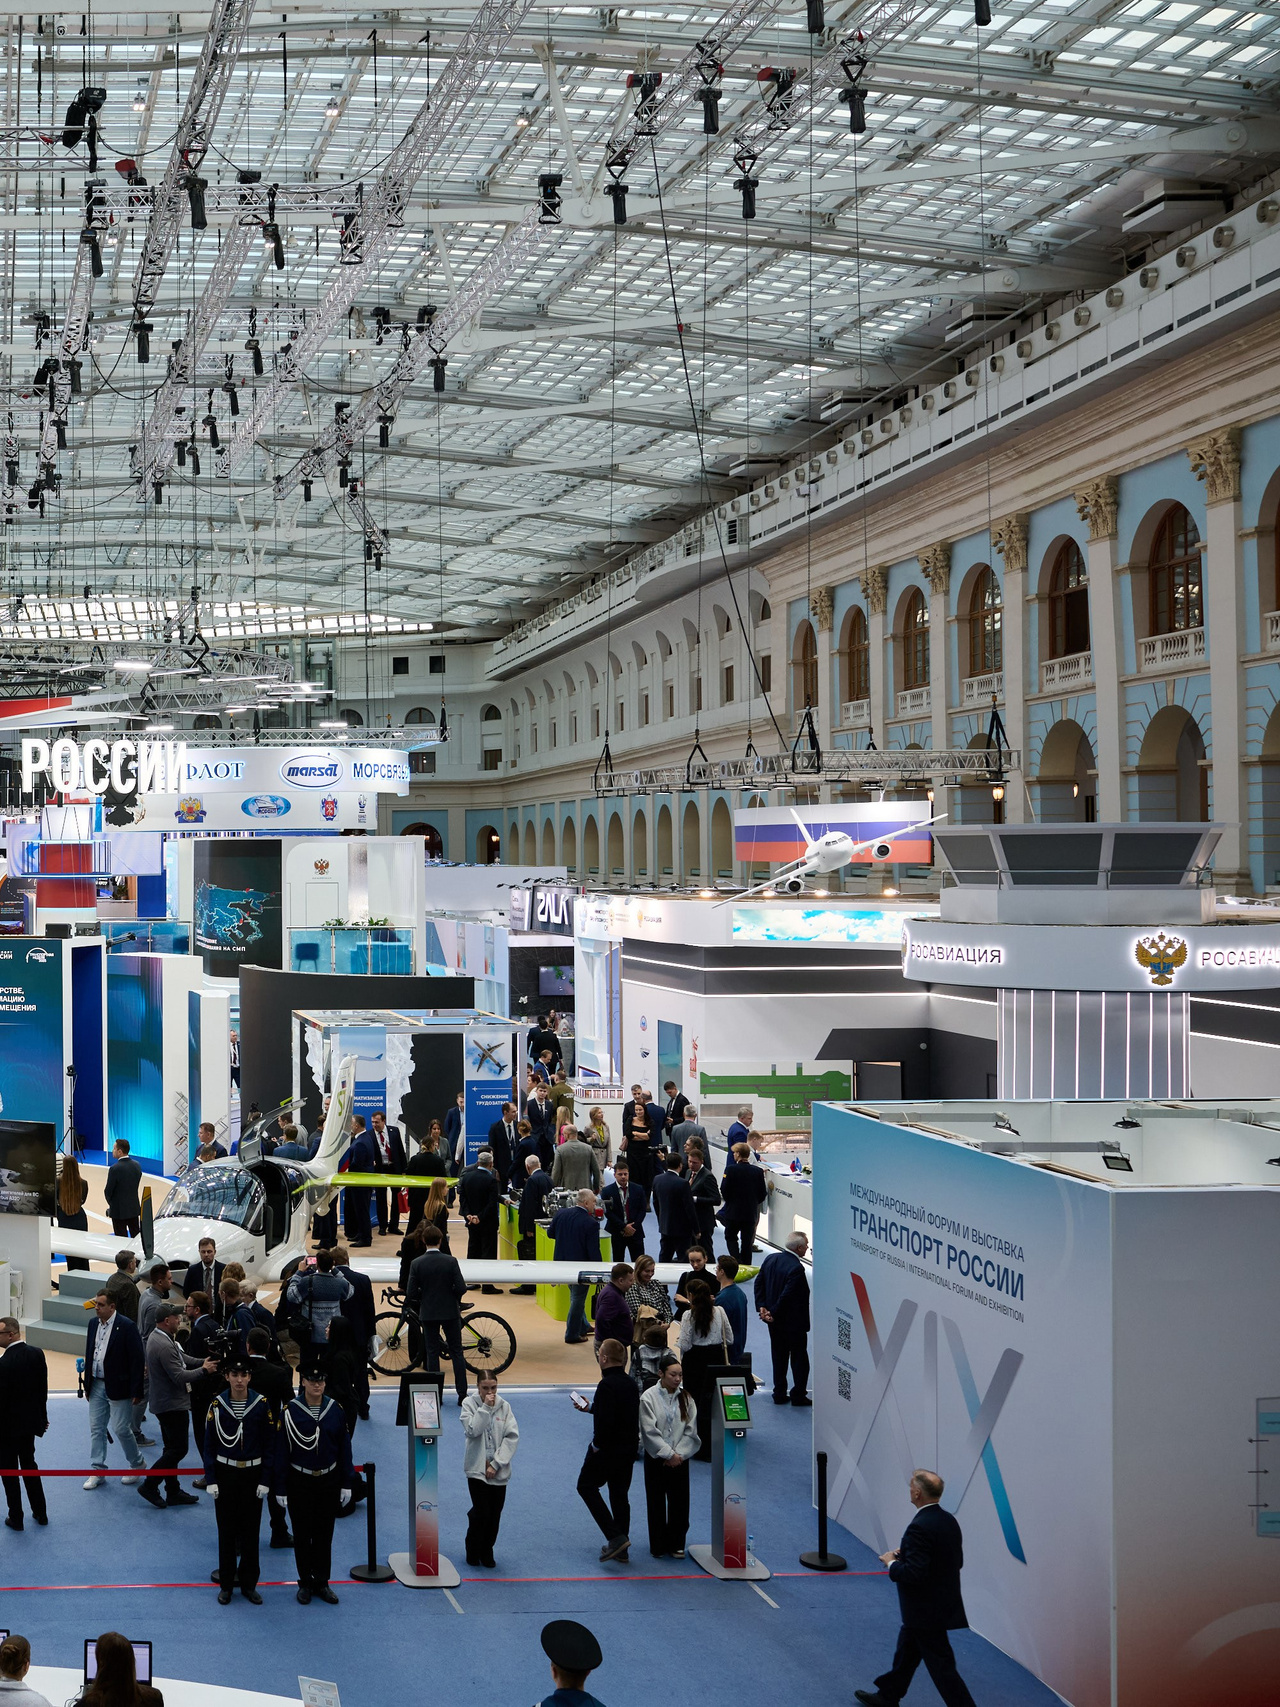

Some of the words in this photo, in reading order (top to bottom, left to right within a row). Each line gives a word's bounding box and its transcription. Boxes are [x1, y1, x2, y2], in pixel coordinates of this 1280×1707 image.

[21, 738, 187, 794] РОССИИ
[911, 944, 1001, 965] РОСАВИАЦИЯ
[850, 1182, 926, 1222] МЕЖДУНАРОДНЫЙ
[927, 1212, 960, 1237] ФОРУМ
[962, 1226, 970, 1240] И
[971, 1228, 1025, 1262] ВЫСТАВКА
[850, 1205, 943, 1265] ТРАНСПОРТ
[947, 1244, 1024, 1301] РОССИИ
[850, 1237, 879, 1258] TRANSPORT
[879, 1251, 887, 1261] OF
[887, 1255, 906, 1270] RUSSIA
[909, 1265, 951, 1290] INTERNATIONAL
[952, 1283, 973, 1300] FORUM
[974, 1293, 988, 1307] AND
[988, 1299, 1024, 1323] EXHIBITION
